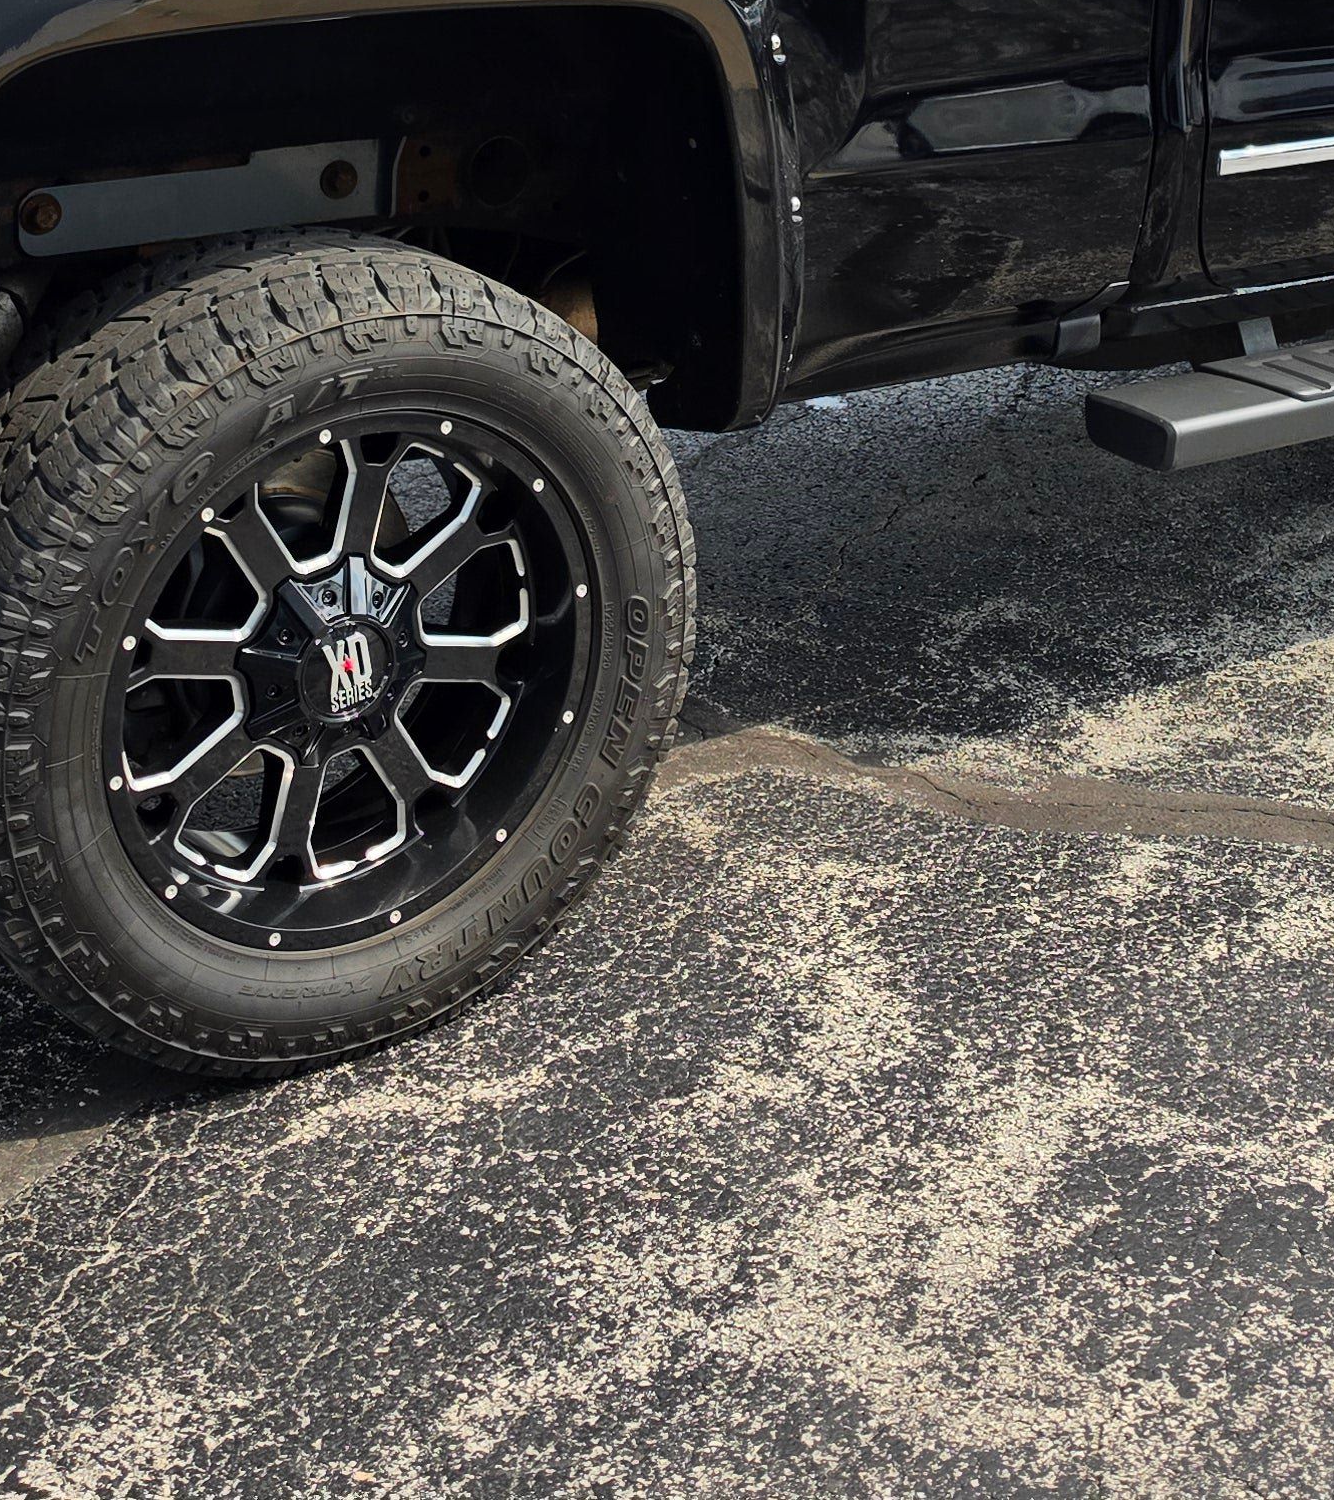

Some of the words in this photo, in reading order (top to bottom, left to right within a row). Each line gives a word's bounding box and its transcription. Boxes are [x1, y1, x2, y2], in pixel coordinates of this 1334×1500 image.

[321, 631, 373, 695] XD
[330, 678, 373, 713] SERIES
[601, 594, 651, 769] OPEN
[378, 780, 603, 999] COUNTRY
